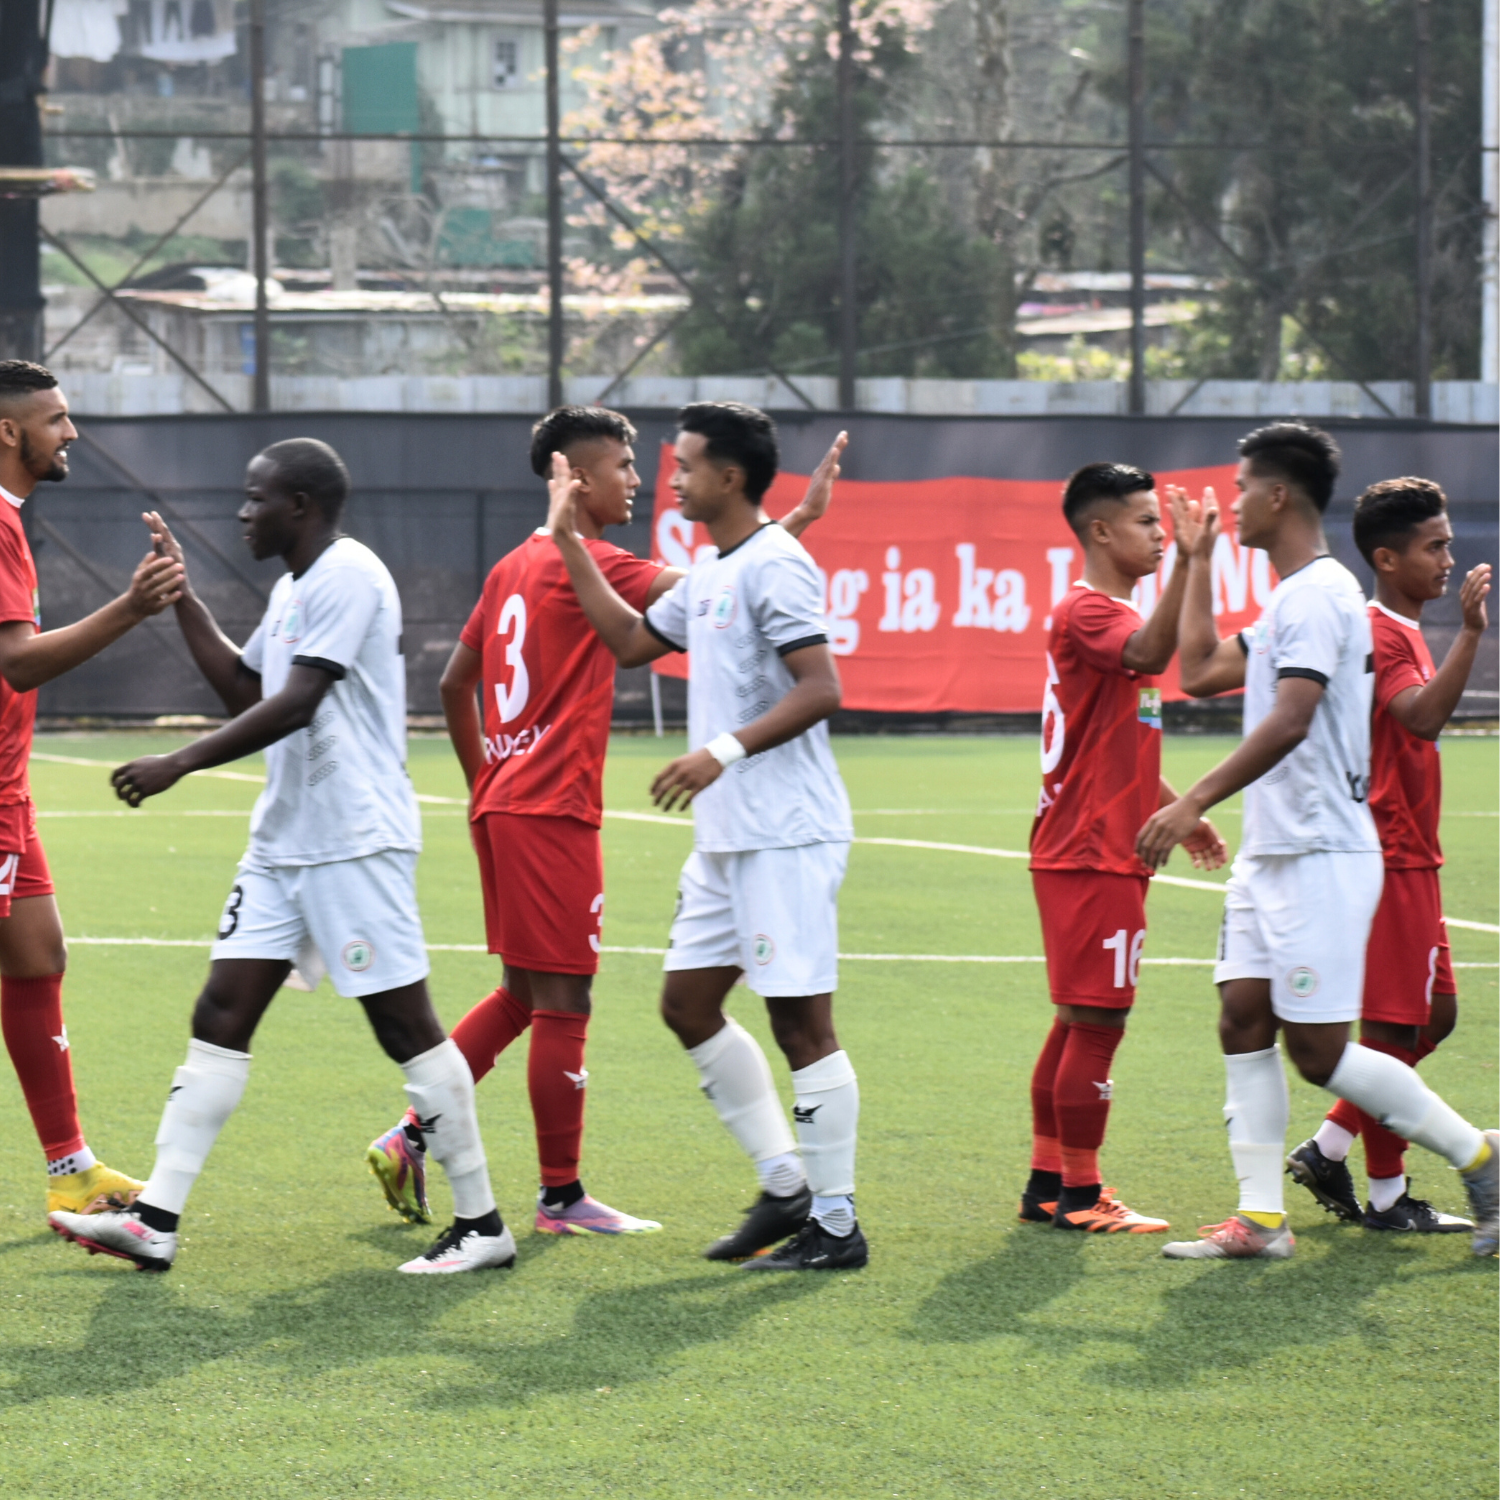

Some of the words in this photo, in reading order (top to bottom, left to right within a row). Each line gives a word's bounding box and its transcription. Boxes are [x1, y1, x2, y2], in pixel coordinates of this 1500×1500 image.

[878, 545, 942, 633] ia
[952, 542, 1033, 633] ka
[494, 593, 530, 724] 3
